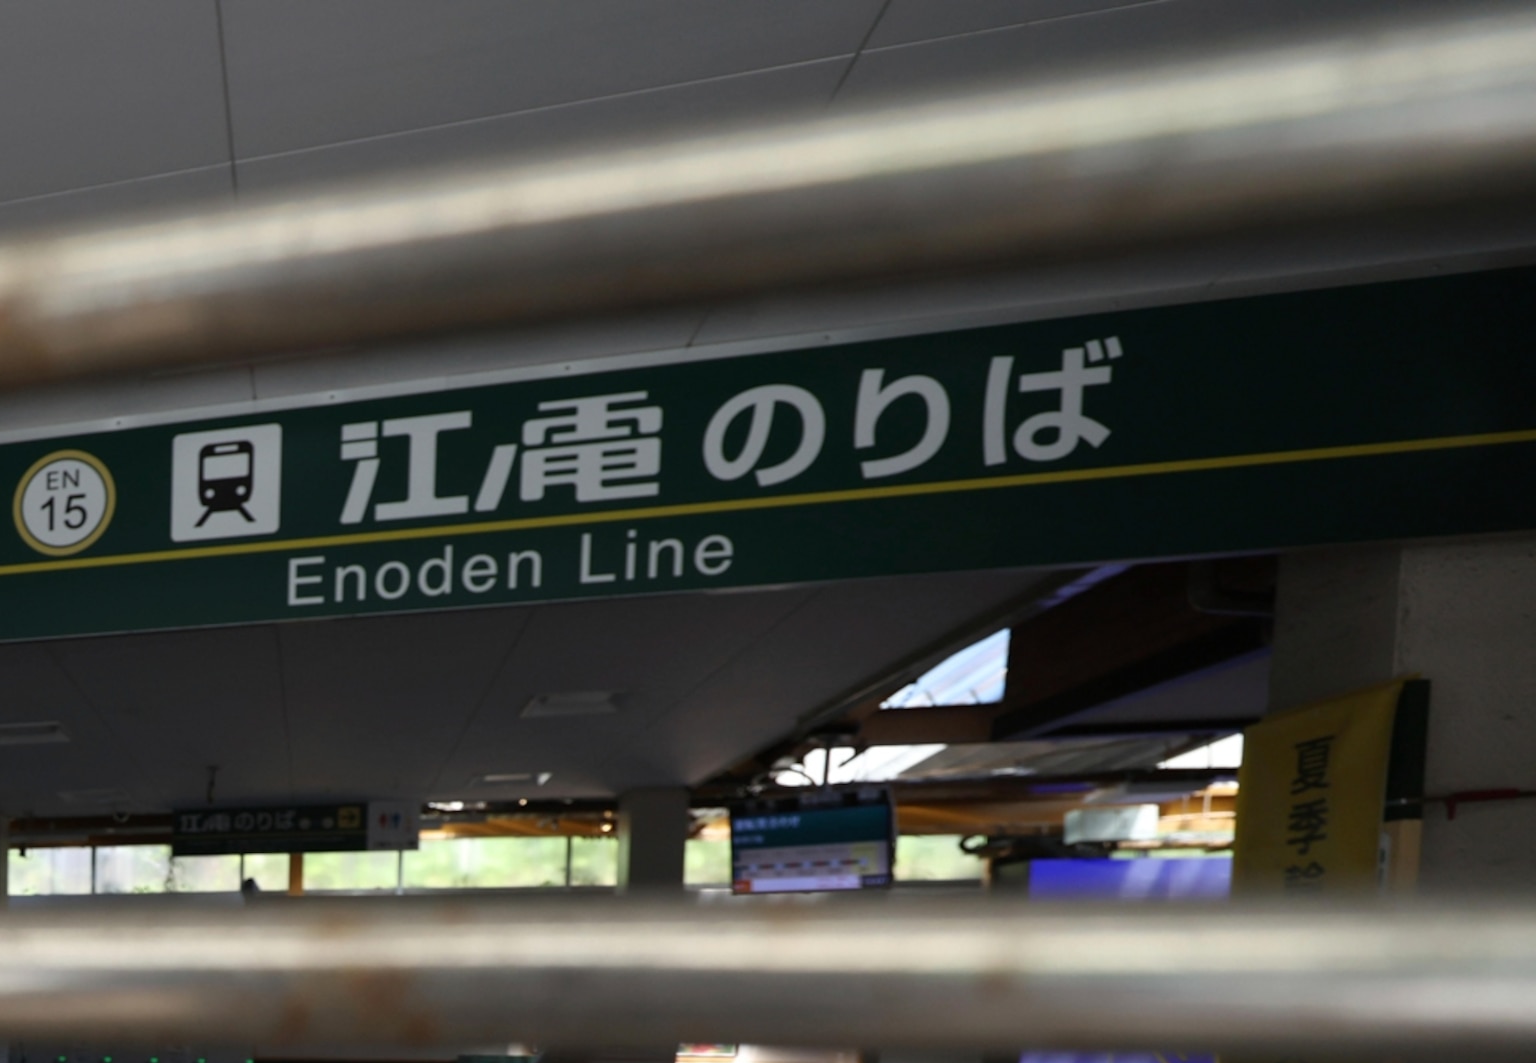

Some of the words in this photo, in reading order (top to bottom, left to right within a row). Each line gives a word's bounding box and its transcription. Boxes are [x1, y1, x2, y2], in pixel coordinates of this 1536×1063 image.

[46, 469, 80, 490] EN
[41, 494, 87, 531] 15
[287, 544, 543, 606] Enoden
[579, 529, 734, 584] Line
